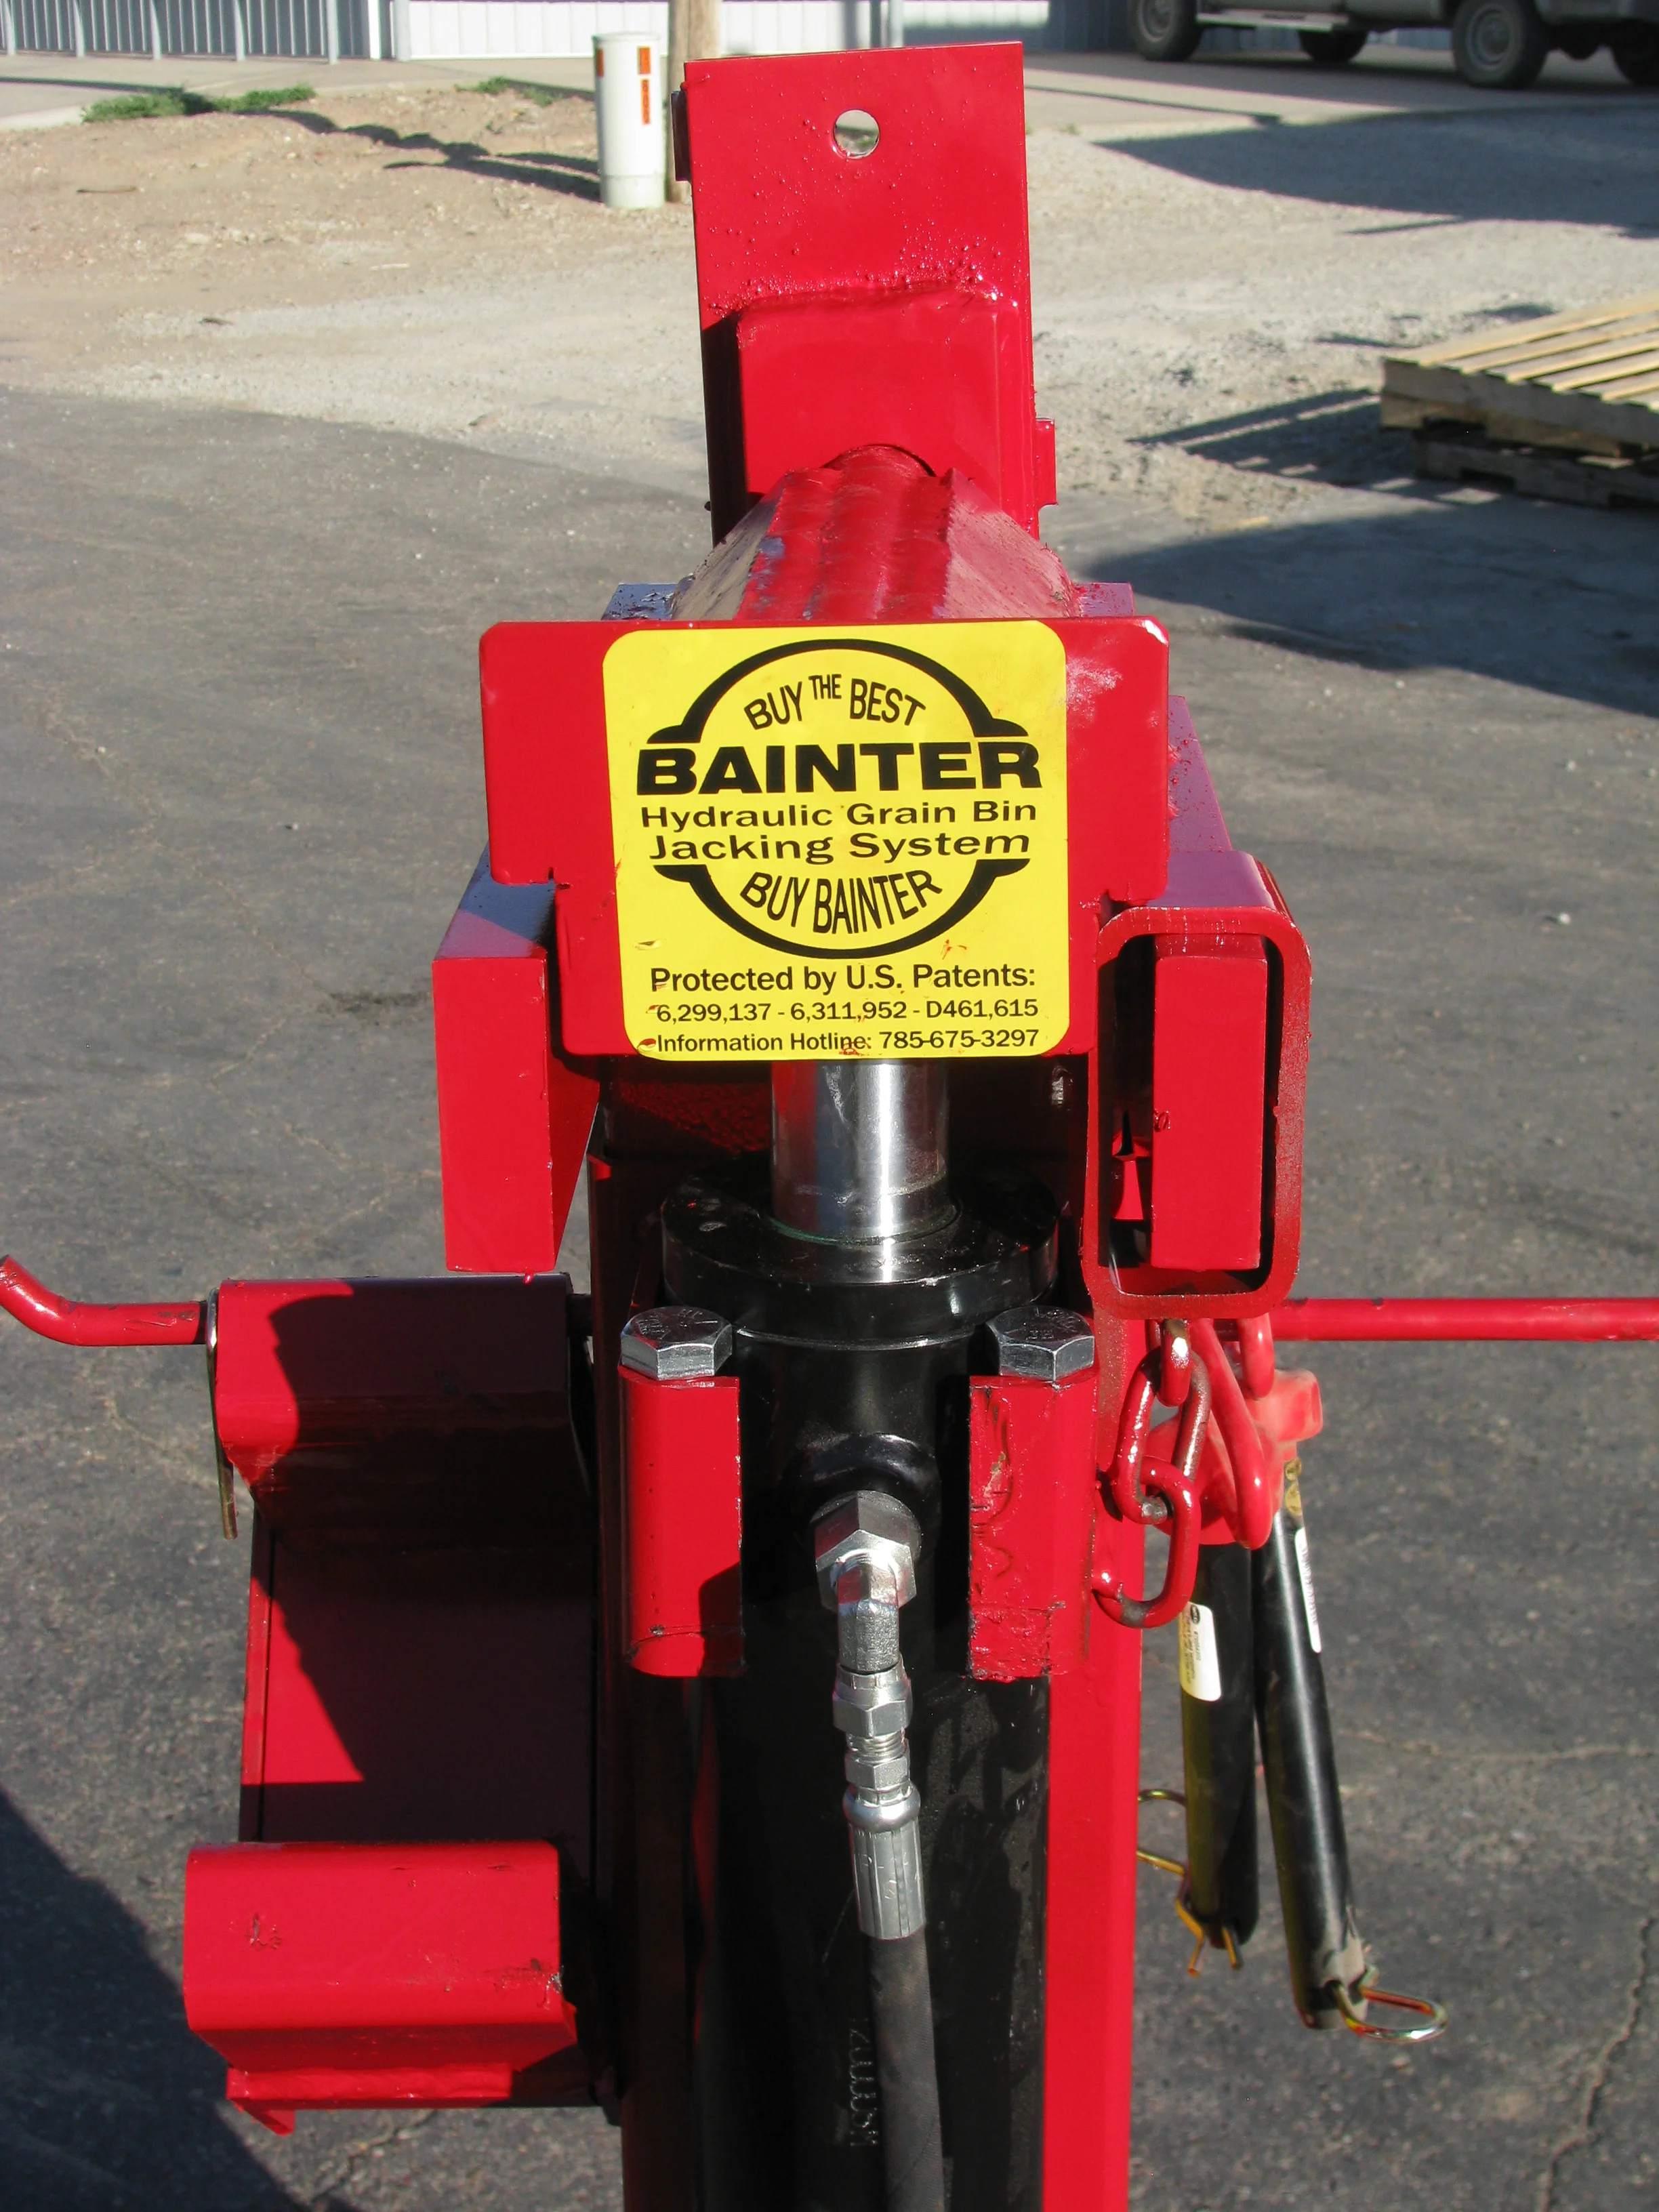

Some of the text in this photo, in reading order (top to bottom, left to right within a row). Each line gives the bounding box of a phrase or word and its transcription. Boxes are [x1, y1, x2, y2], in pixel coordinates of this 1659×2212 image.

[743, 674, 926, 730] BUY THE BEST
[637, 741, 1042, 796] BAINTER
[642, 800, 1036, 833] Hydraulic Grain Bin
[649, 833, 1029, 865] Jacking System
[740, 870, 943, 935] BUY BAINTER
[651, 964, 1035, 996] Protected by U.S. Patents:
[656, 1004, 771, 1025] 6,299,137
[790, 1001, 907, 1023] 6,311,952
[926, 999, 1038, 1021] D461,615
[657, 1029, 1039, 1052] Information Hotline: 785-675-3297
